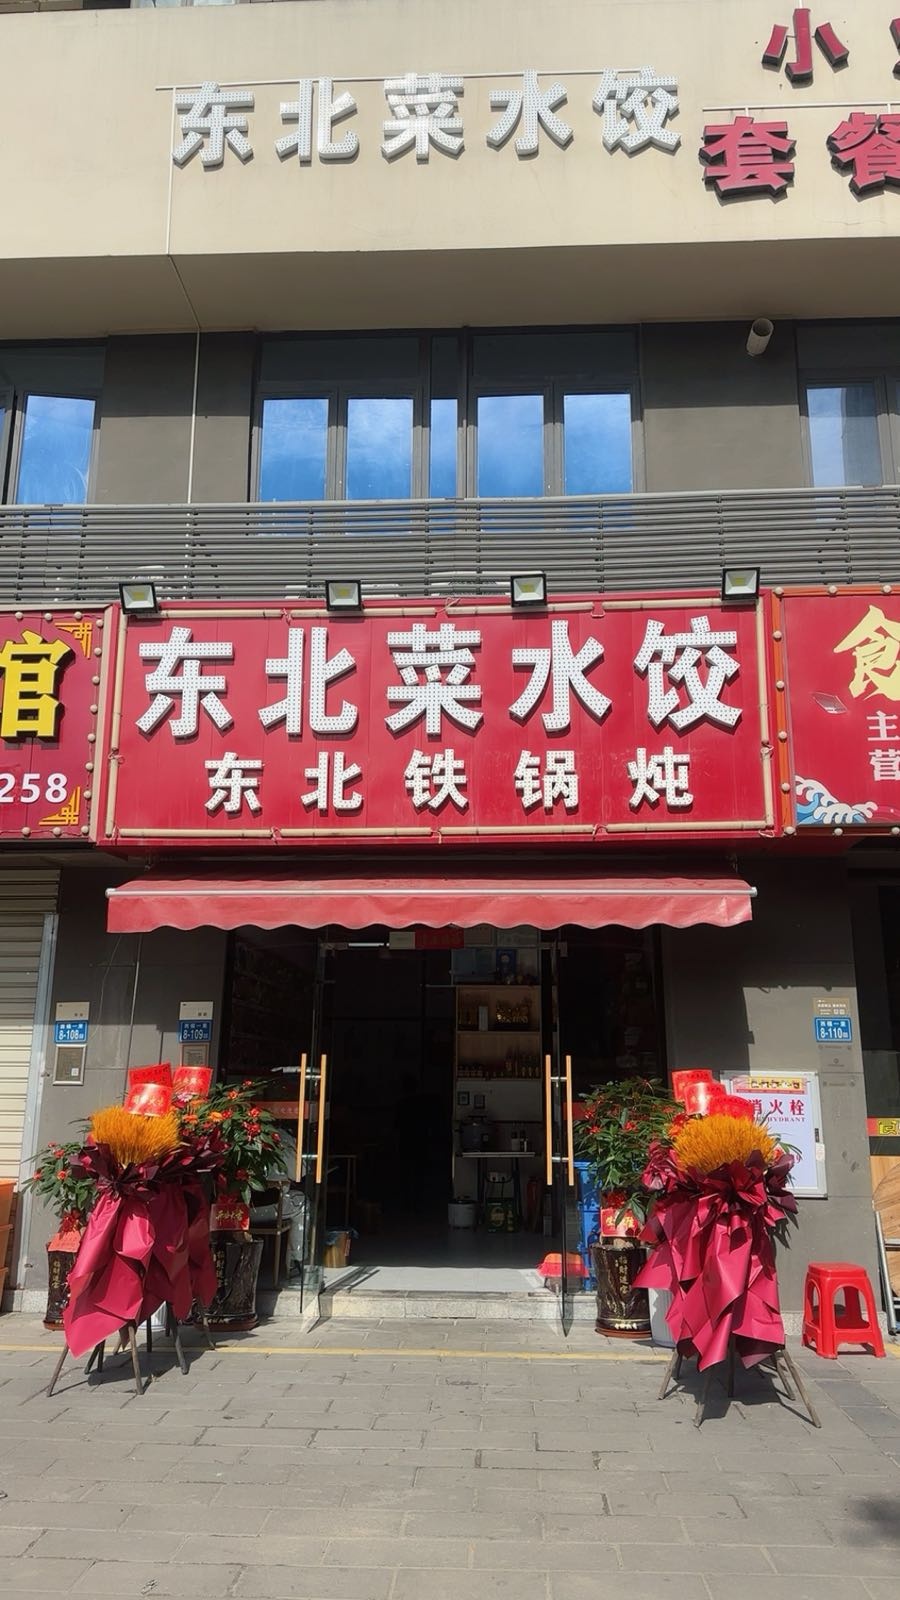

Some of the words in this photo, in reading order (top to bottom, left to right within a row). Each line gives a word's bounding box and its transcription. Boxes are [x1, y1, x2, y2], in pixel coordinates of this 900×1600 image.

[172, 65, 681, 167] 东北菜水饺
[135, 615, 743, 738] 东北菜水饺
[0, 773, 67, 803] 258
[204, 746, 694, 813] 东北铁锅炖
